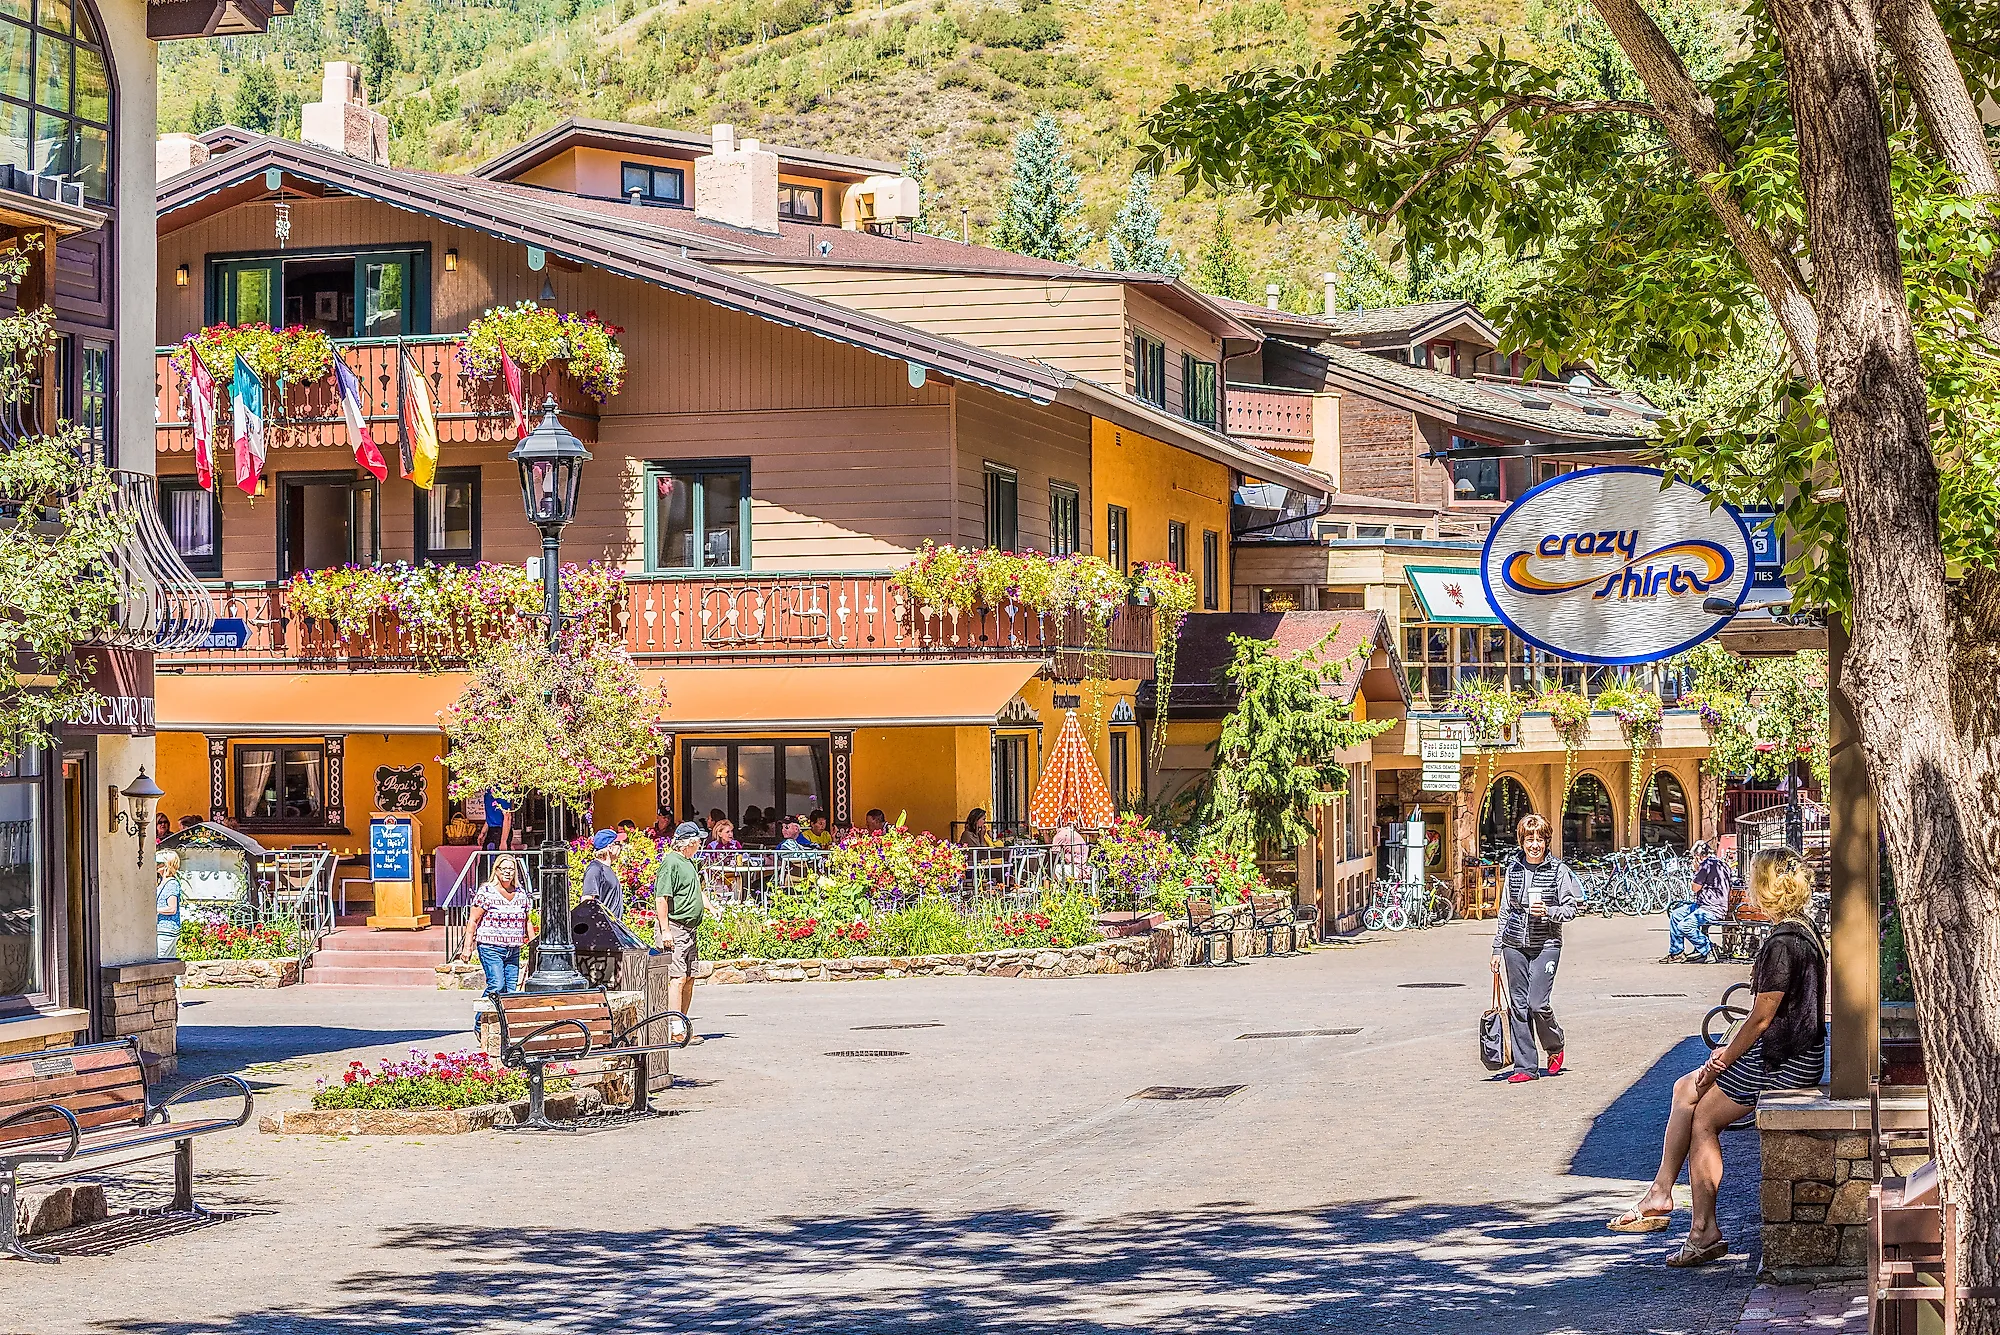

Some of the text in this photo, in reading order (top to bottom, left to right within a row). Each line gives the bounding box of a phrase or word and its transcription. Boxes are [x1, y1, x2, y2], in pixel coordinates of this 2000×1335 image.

[1536, 529, 1639, 561] crazy
[1592, 564, 1709, 600] shirts
[62, 696, 140, 726] ESIGNER
[382, 775, 417, 793] Pepi's
[396, 792, 420, 806] Bar
